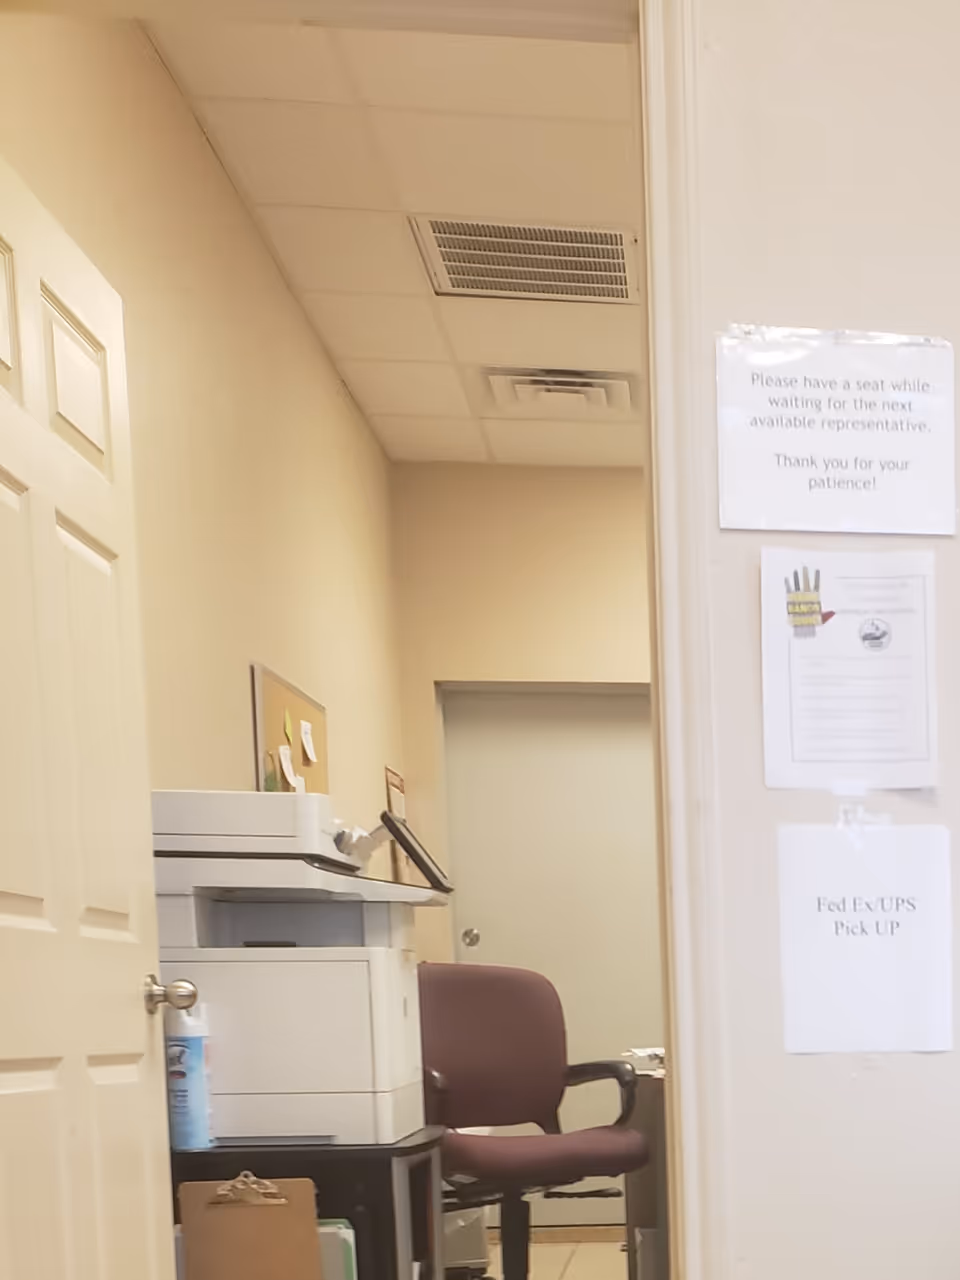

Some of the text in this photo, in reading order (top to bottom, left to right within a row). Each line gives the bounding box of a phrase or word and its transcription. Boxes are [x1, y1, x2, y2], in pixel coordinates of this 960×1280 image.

[751, 372, 931, 393] Please have a seat while
[768, 395, 913, 412] waiting for the next
[750, 414, 932, 433] available representative.
[775, 453, 910, 473] Thank you for your
[808, 475, 877, 492] patience!
[816, 896, 918, 913] Fed Ex/UPS
[833, 920, 901, 937] Pick UP
